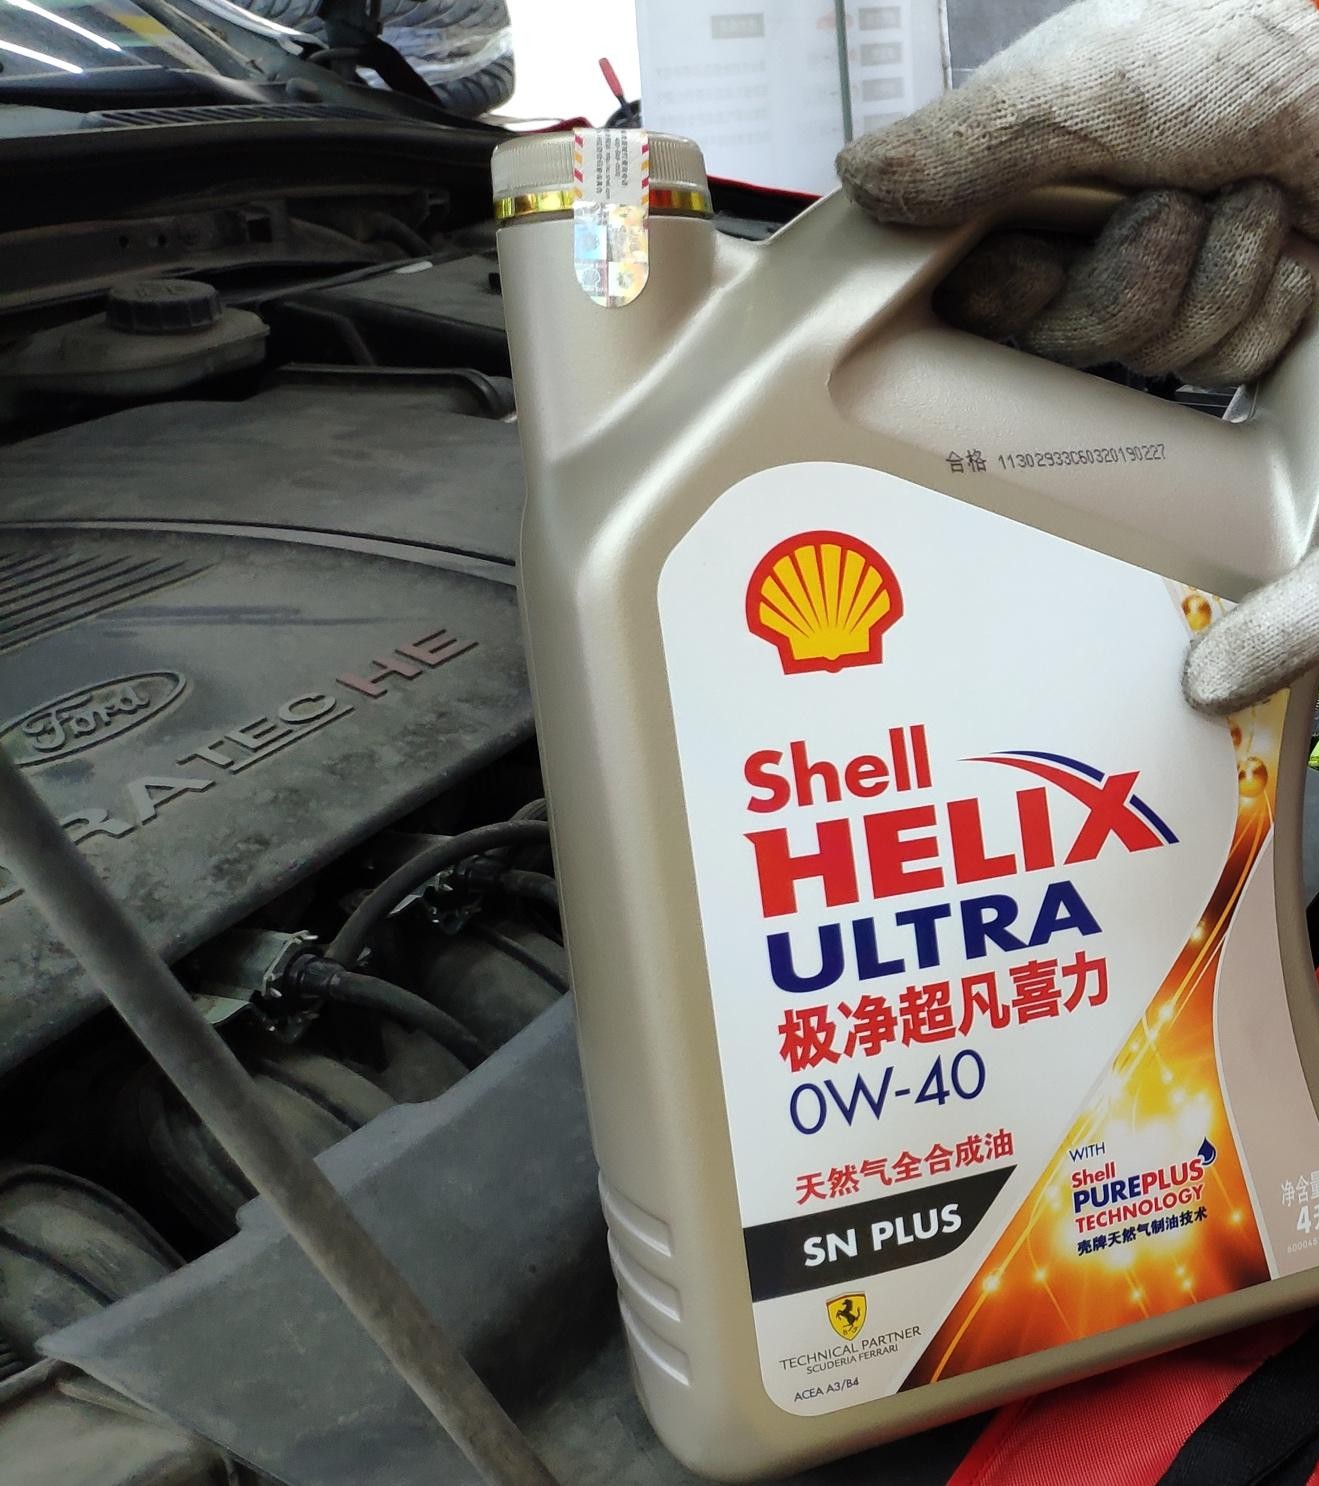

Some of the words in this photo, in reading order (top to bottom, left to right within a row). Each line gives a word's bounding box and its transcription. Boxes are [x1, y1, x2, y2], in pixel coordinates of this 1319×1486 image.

[945, 449, 987, 474] 合格
[336, 629, 480, 699] HE
[21, 684, 151, 753] Ford
[744, 724, 932, 813] Shell
[743, 757, 1167, 918] HELIX
[766, 880, 1103, 993] ULTRA
[778, 951, 1110, 1073] 极净超凡喜力
[790, 1049, 986, 1135] 0W-40
[795, 1128, 1014, 1205] 天然气全合成油
[1069, 1141, 1106, 1162] WITH
[1071, 1161, 1116, 1189] Shell
[1073, 1158, 1204, 1214] PUREPLUS
[1075, 1184, 1204, 1234] TECHNOLOGY
[803, 1229, 858, 1267] SN
[871, 1203, 962, 1251] PLUS
[1077, 1206, 1208, 1256] 壳牌天然气制油技术
[779, 1343, 859, 1370] TECHNICAL
[861, 1325, 922, 1350] PARTNER
[806, 1354, 857, 1375] SCUDERIA
[859, 1343, 899, 1363] FERRARI
[793, 1387, 824, 1402] ACEA
[826, 1376, 860, 1394] A3/B4
